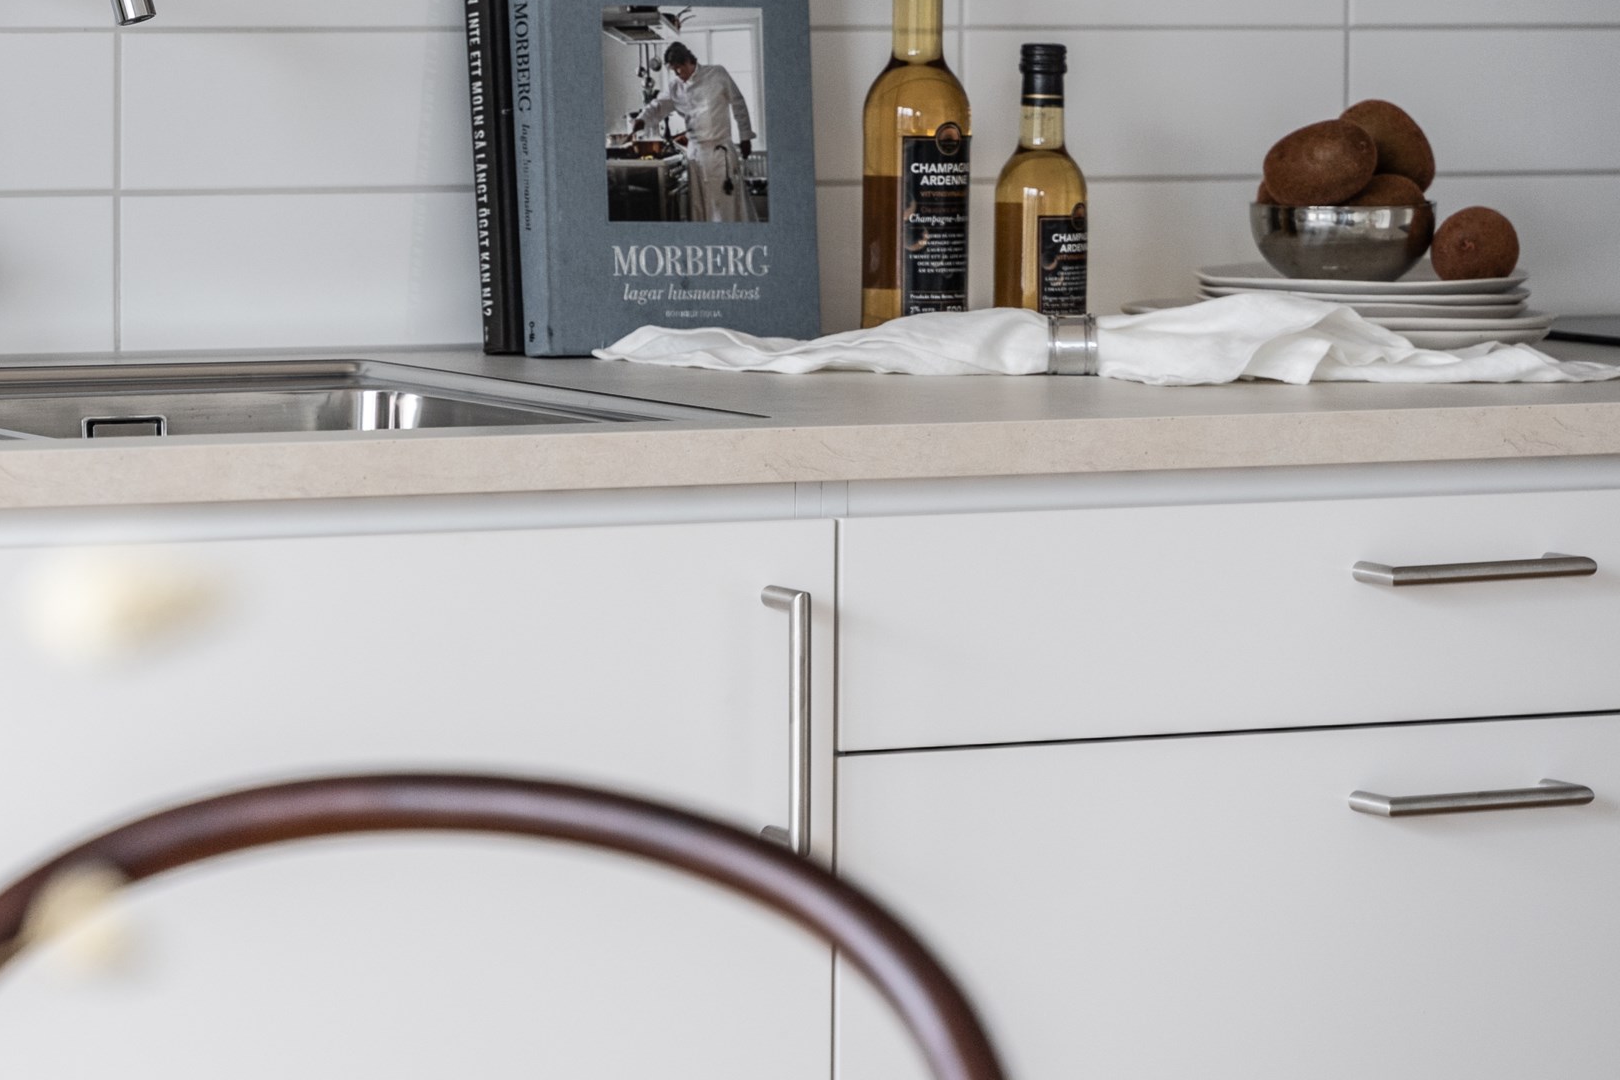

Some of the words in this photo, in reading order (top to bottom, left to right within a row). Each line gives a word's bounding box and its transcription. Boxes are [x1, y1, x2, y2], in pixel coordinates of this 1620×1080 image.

[467, 11, 481, 47] INTE
[470, 50, 482, 77] ETT
[514, 2, 532, 115] MORBERG
[471, 81, 485, 126] MOLN
[520, 123, 531, 156] lagar
[480, 251, 491, 283] KAN
[611, 244, 771, 277] MORBERG
[623, 282, 664, 305] lagar
[667, 282, 761, 301] husmanskost
